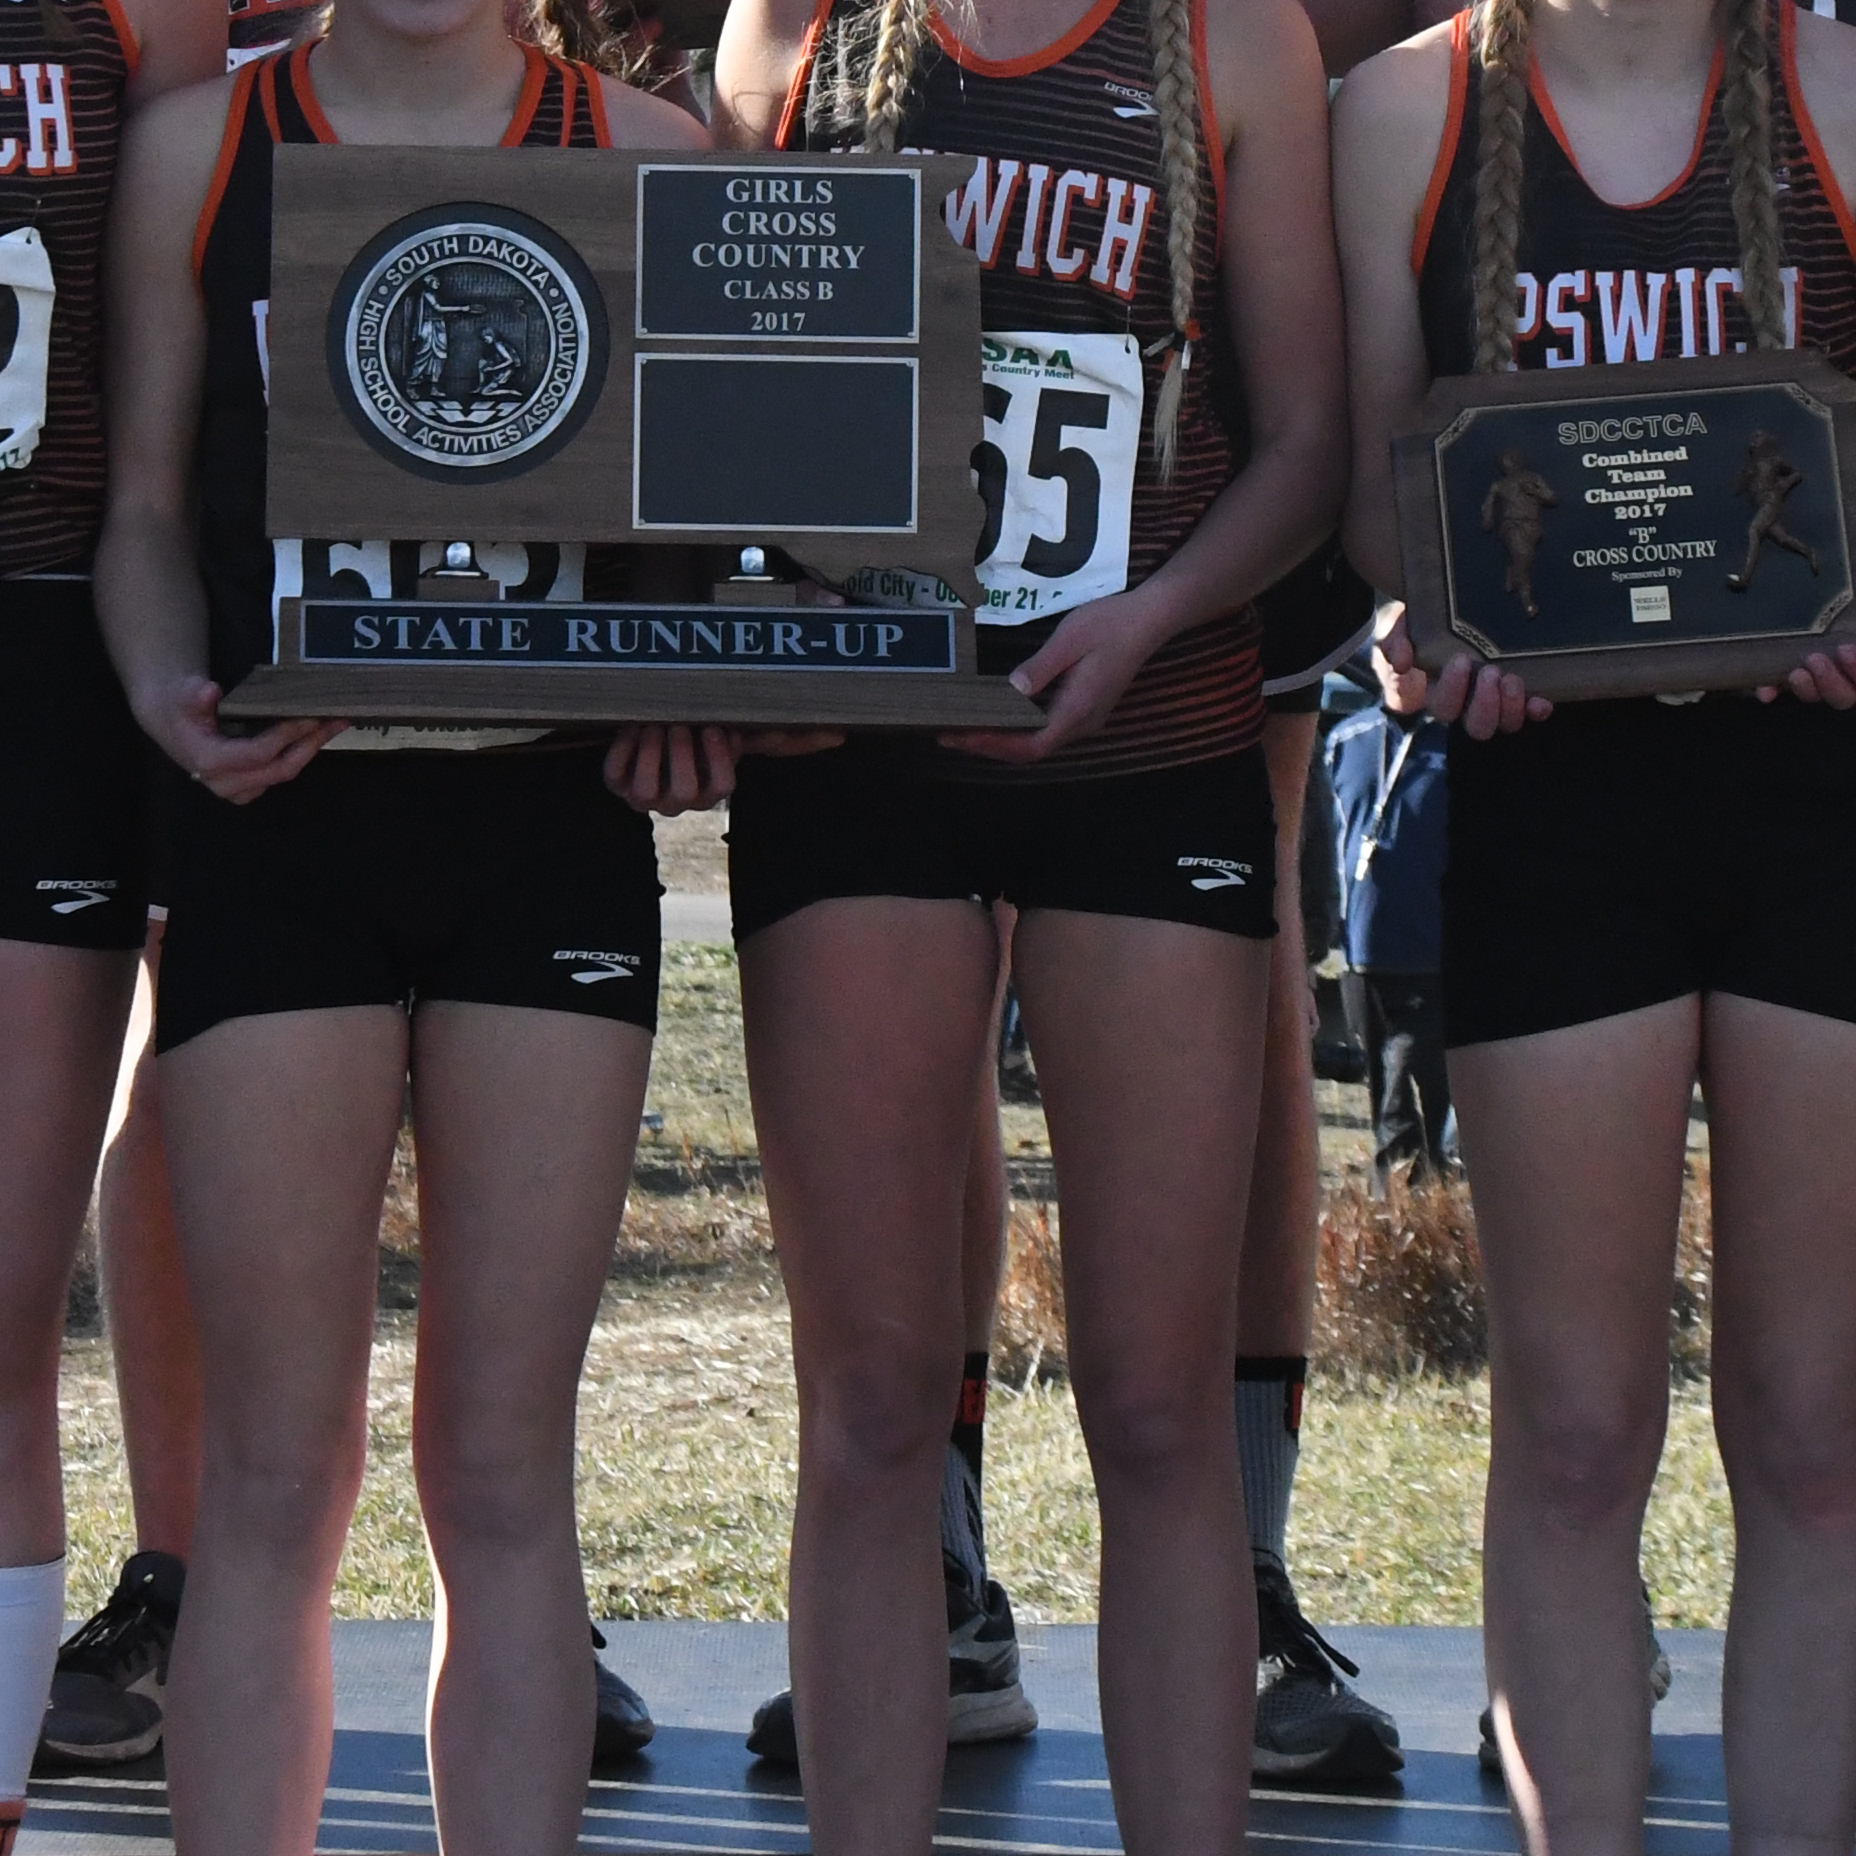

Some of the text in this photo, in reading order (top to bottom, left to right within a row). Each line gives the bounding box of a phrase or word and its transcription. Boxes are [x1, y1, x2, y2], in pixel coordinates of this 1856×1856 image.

[726, 178, 834, 204] GIRLS
[722, 211, 836, 236] CROSS
[945, 156, 1156, 301] WICH
[386, 235, 552, 290] SOUTH DAKOTA
[692, 242, 865, 269] COUNTRY
[724, 280, 834, 300] CLASS B
[751, 311, 806, 332] 2017
[982, 337, 1074, 370] SAA
[359, 299, 577, 454] HIGH SCHOOL ACTIVITIES ASSOCIATION
[992, 364, 1040, 378] Country
[1045, 368, 1075, 380] Meet
[1558, 412, 1708, 445] SDCCTCA
[1582, 446, 1689, 468] Combined
[1607, 469, 1667, 484] Team
[1584, 484, 1693, 504] Champion
[1614, 503, 1667, 520] 2017
[1573, 540, 1718, 568] CROSS COUNTRY
[1611, 566, 1683, 583] Sponsored By
[880, 573, 916, 602] City
[353, 615, 904, 658] STATE RUNNER-UP
[1177, 856, 1253, 874] BROOKS
[36, 880, 118, 890] BROOKS
[552, 950, 641, 965] BROOKS
